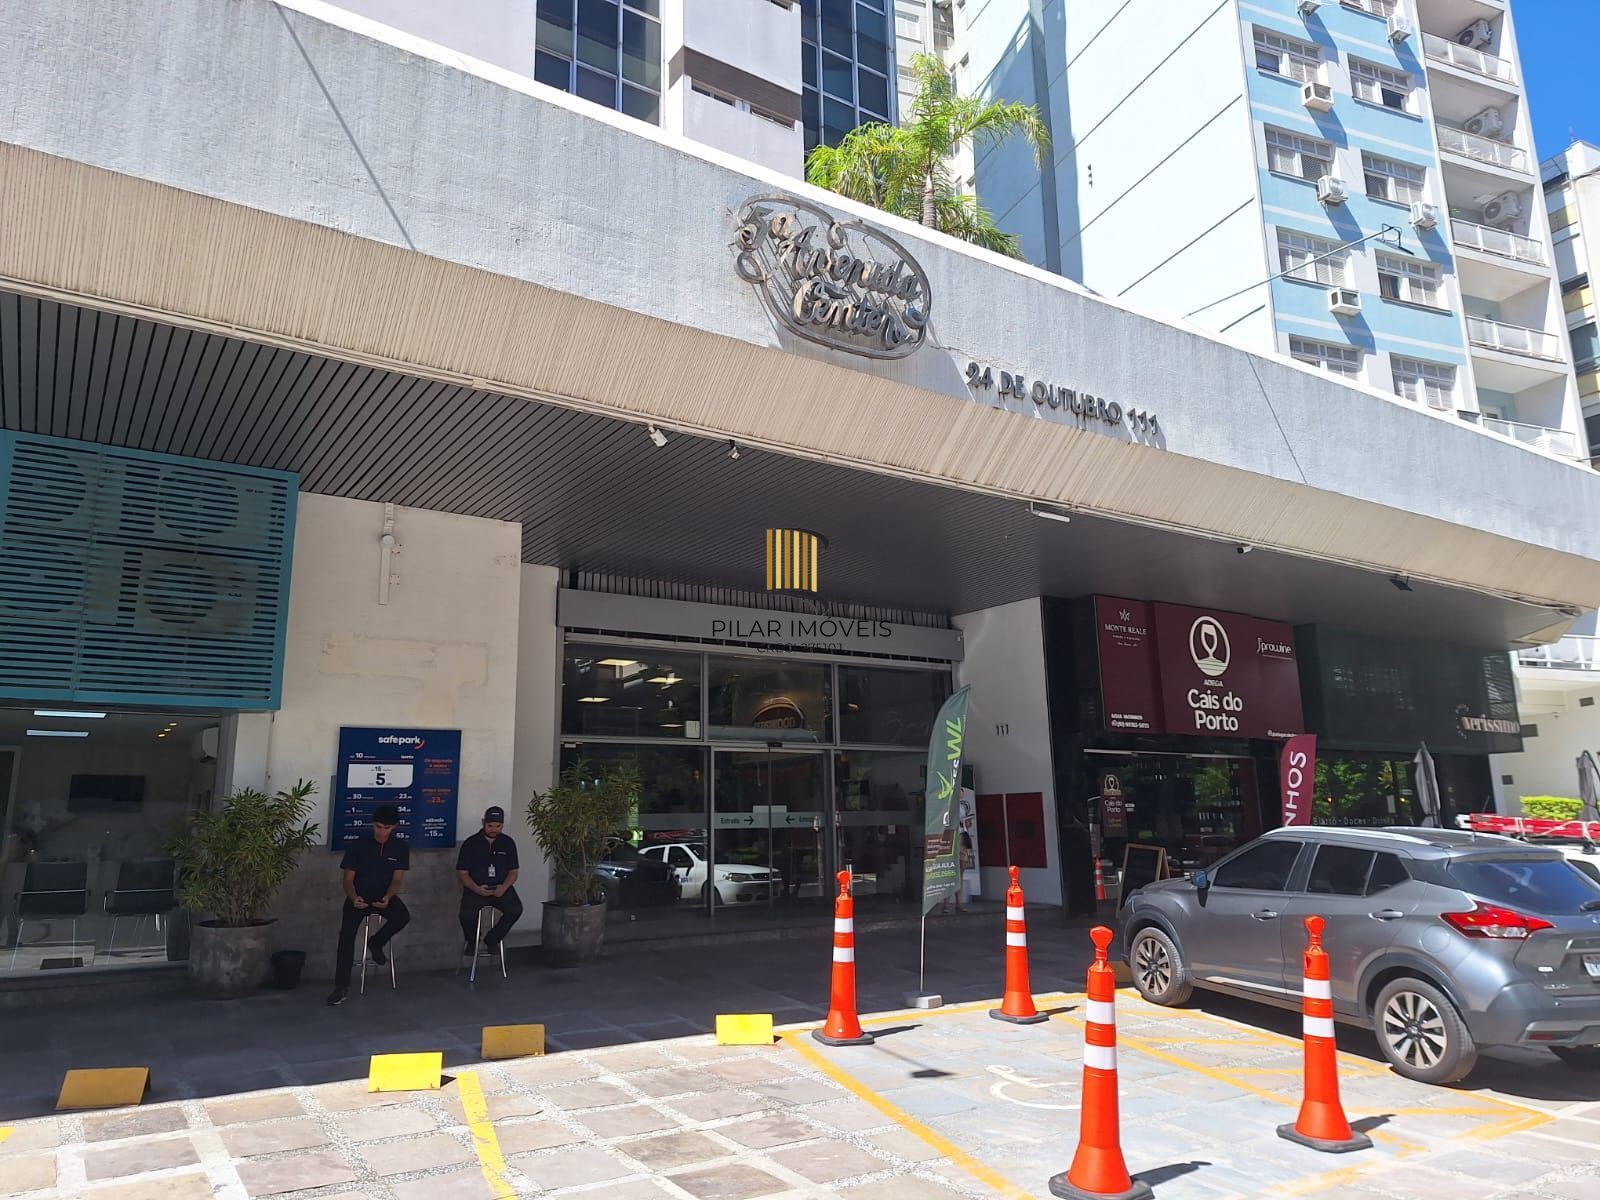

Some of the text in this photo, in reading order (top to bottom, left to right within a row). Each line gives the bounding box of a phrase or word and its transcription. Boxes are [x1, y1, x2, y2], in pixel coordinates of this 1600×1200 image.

[779, 226, 922, 301] Avenida
[792, 276, 912, 350] Center
[966, 361, 1158, 435] 24 DE OUTUBRO 111
[1105, 623, 1147, 636] MONTE REALE
[1203, 678, 1224, 688] ADEGA
[1188, 688, 1243, 712] Cais do
[1195, 710, 1239, 731] Porto
[996, 724, 1009, 736] 111
[378, 735, 421, 745] safepark
[376, 773, 386, 786] 5
